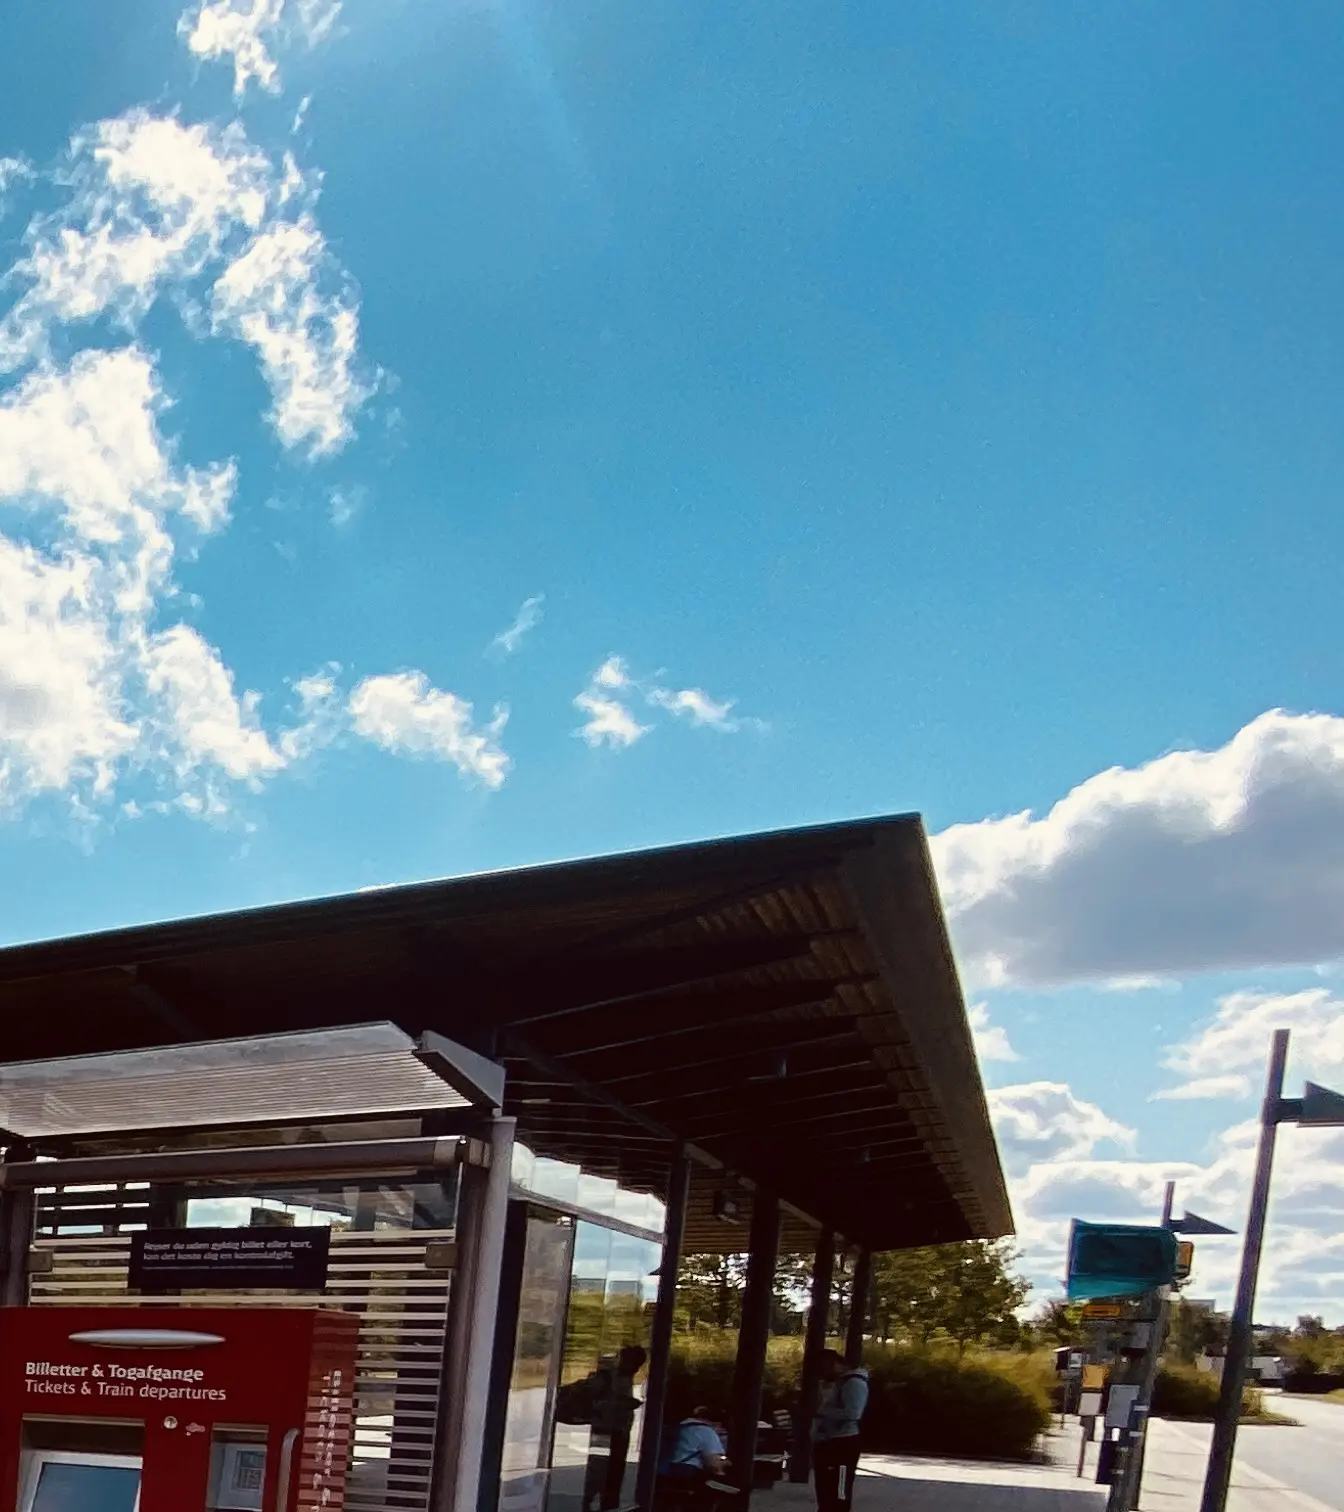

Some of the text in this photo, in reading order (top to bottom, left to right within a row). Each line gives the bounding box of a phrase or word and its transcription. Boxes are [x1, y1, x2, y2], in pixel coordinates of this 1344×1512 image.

[25, 1362, 204, 1382] Billetter & Togafgange
[24, 1379, 226, 1400] Tickets & Train departures
